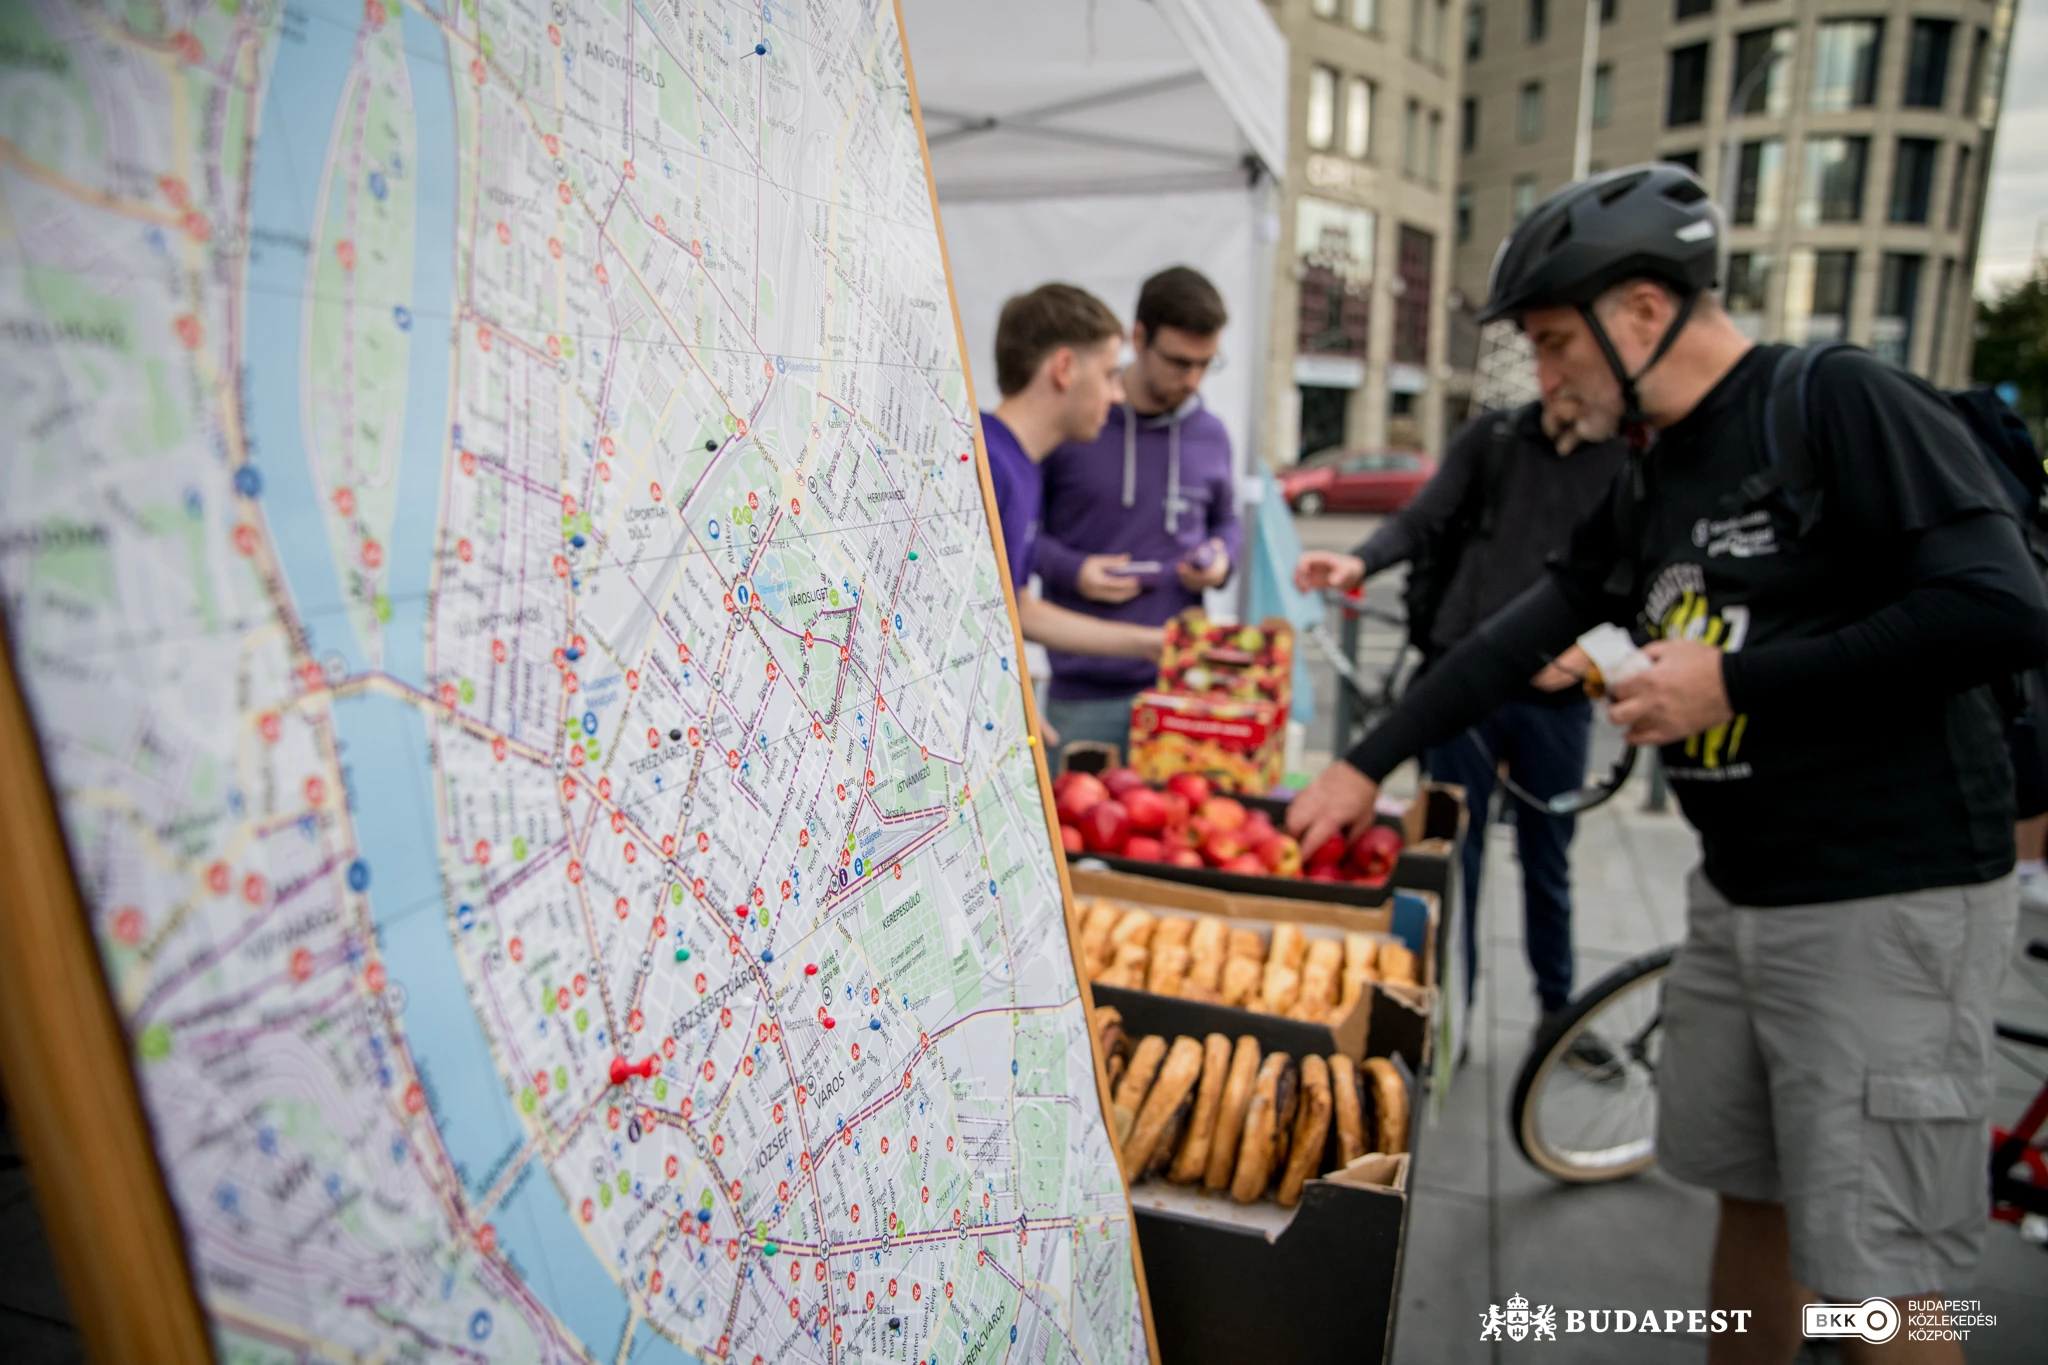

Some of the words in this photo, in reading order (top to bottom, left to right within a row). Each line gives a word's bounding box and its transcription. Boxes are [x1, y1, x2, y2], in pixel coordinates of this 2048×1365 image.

[752, 434, 780, 474] Hungária
[788, 587, 829, 608] VÁROSLIGET
[896, 763, 931, 795] ISTVÁNMEZŐ
[882, 890, 922, 931] KEREPESDŰLŐ
[813, 1070, 845, 1110] VÁROS
[838, 1145, 847, 1166] Futó
[831, 1159, 850, 1217] Vajdahunyad
[871, 1196, 881, 1239] Leonardo
[929, 1285, 938, 1315] Telepy
[901, 1315, 909, 1363] Lenhossék
[921, 1305, 930, 1340] Sobieski
